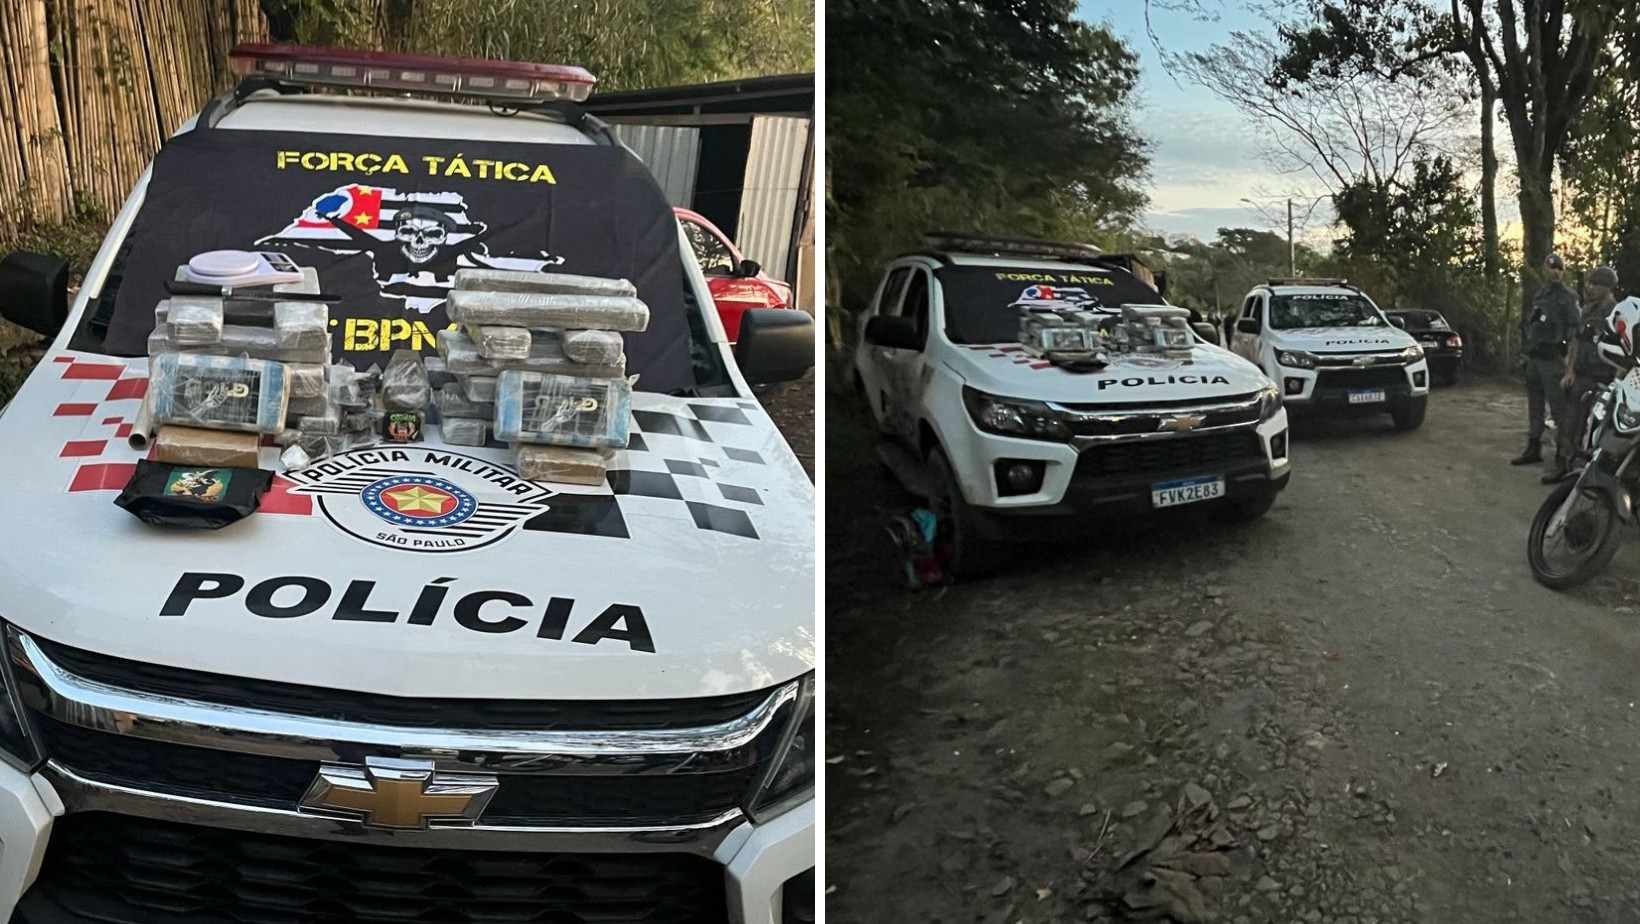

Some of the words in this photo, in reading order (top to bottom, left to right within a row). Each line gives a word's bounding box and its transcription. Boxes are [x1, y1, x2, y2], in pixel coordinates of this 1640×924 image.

[276, 150, 409, 176] FORÇA
[422, 153, 557, 185] TÁTICA
[1059, 273, 1115, 286] TÁTICA
[1097, 375, 1230, 390] POLÍCIA
[301, 450, 410, 482] POLÍCIA
[424, 452, 533, 496] MILITAR
[1159, 483, 1219, 505] FVK2E83
[376, 532, 407, 545] SÃO
[413, 537, 466, 548] PAULO
[159, 571, 657, 653] POLÍCIA
